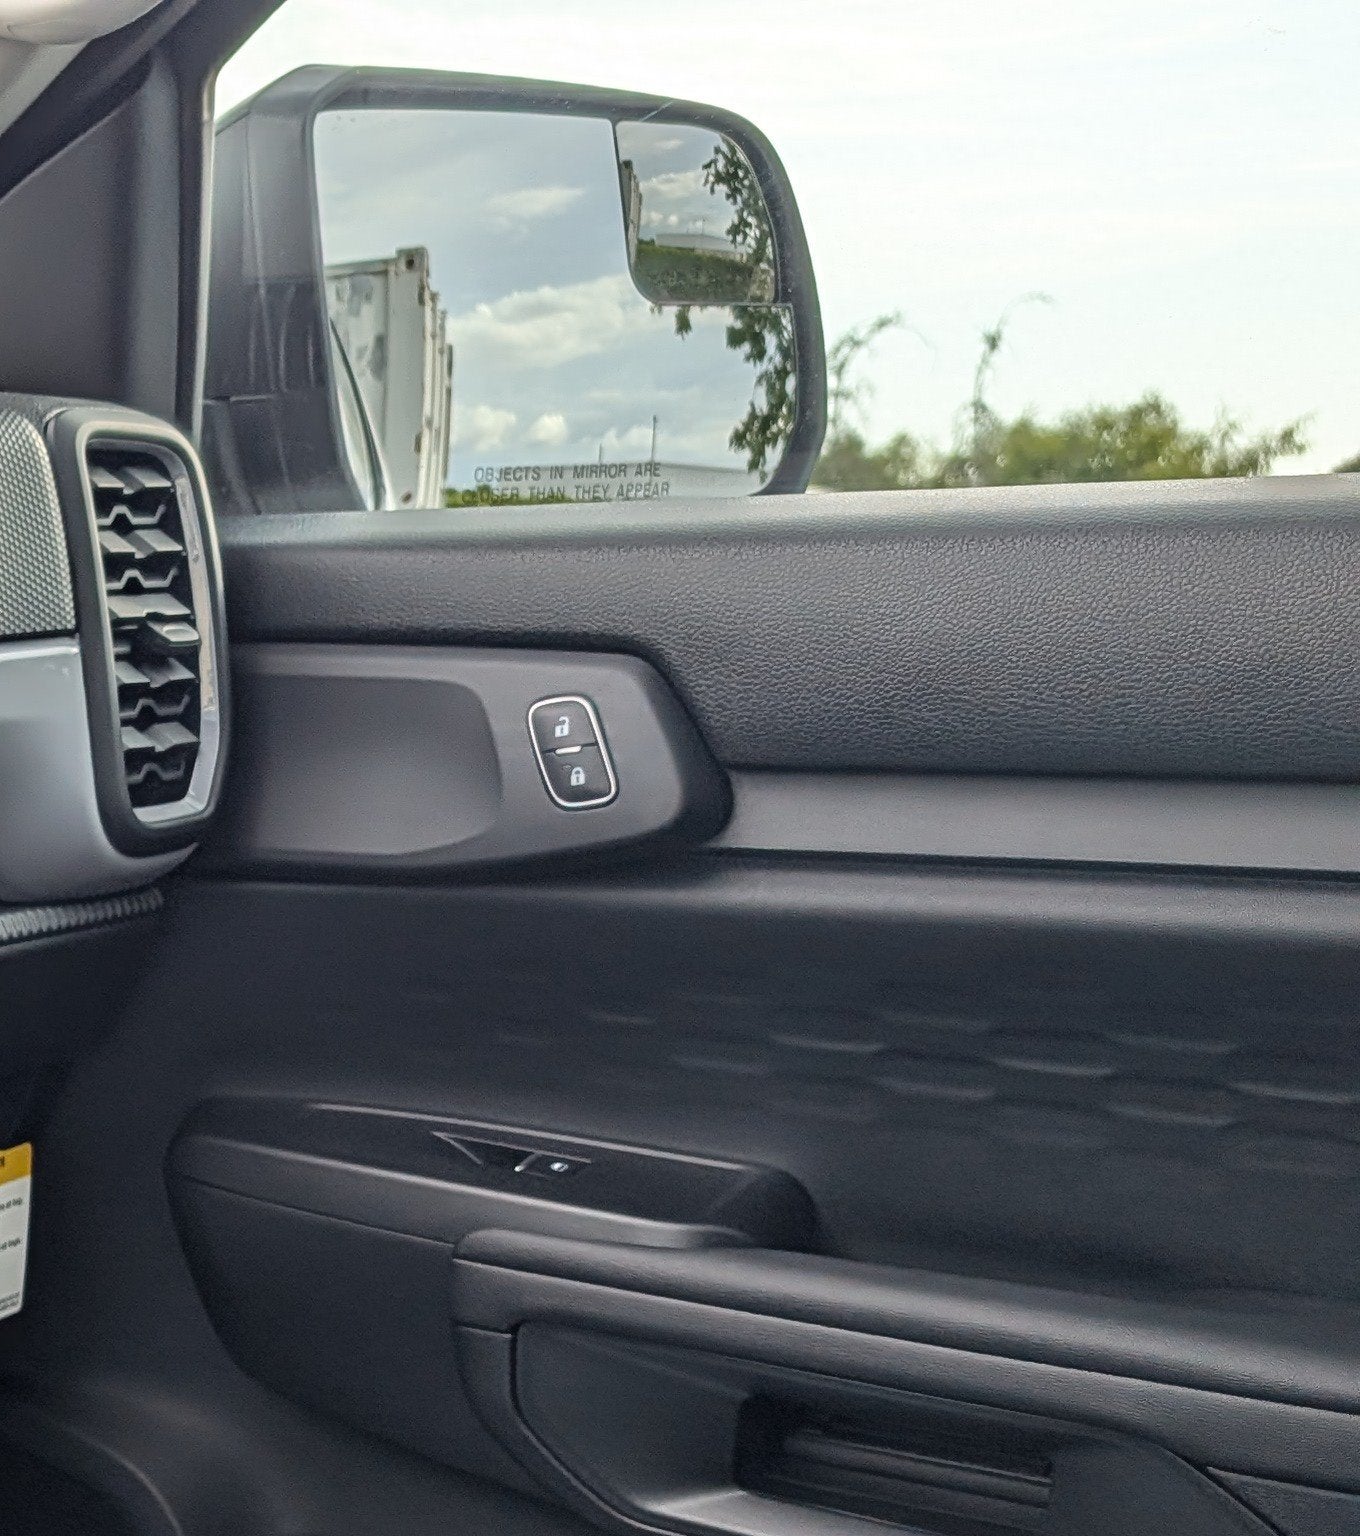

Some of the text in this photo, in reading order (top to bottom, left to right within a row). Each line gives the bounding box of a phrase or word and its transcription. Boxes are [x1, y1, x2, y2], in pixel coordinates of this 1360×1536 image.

[474, 462, 661, 483] OBJECTS IN MIRROR ARE
[529, 485, 566, 502] THAN
[574, 484, 611, 502] THEY
